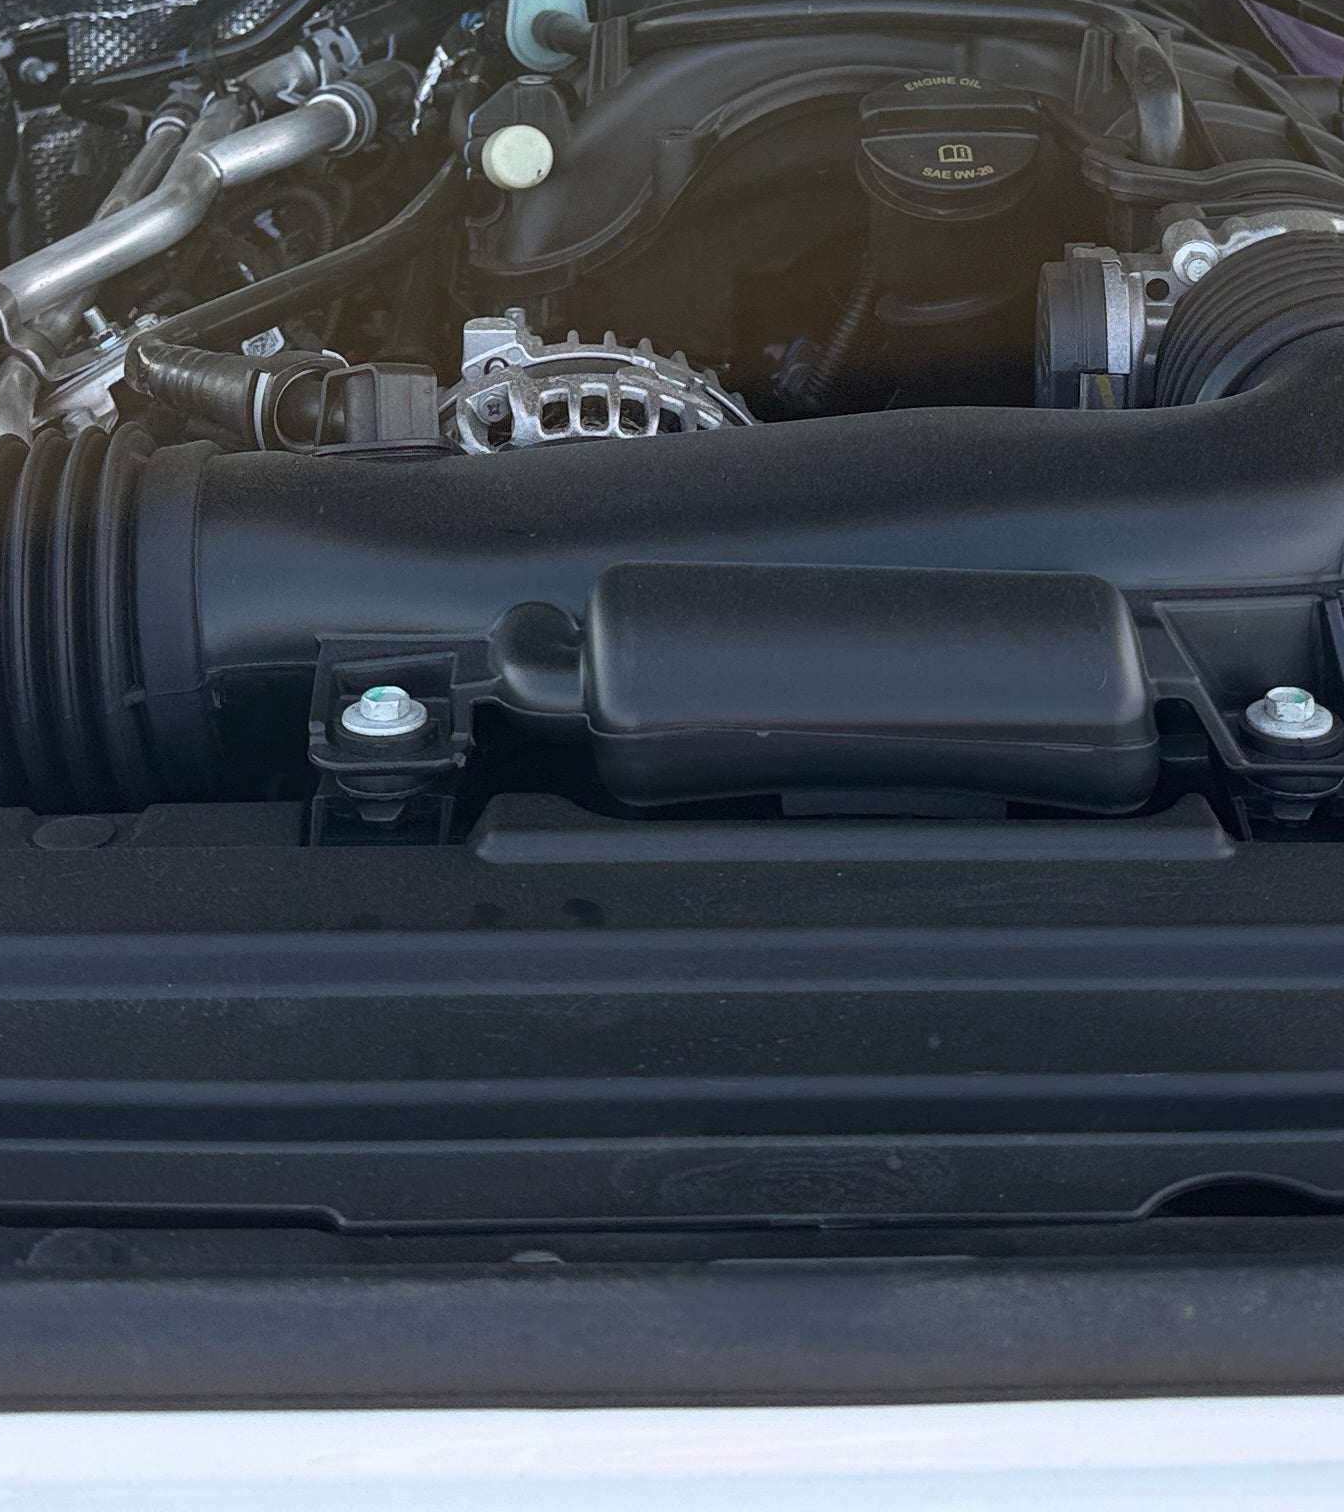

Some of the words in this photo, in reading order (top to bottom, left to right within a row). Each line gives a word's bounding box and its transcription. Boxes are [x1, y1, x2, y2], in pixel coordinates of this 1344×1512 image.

[904, 76, 956, 91] ENGINE
[959, 78, 982, 89] OIL
[922, 167, 952, 179] SAE
[954, 165, 994, 180] 0W-20
